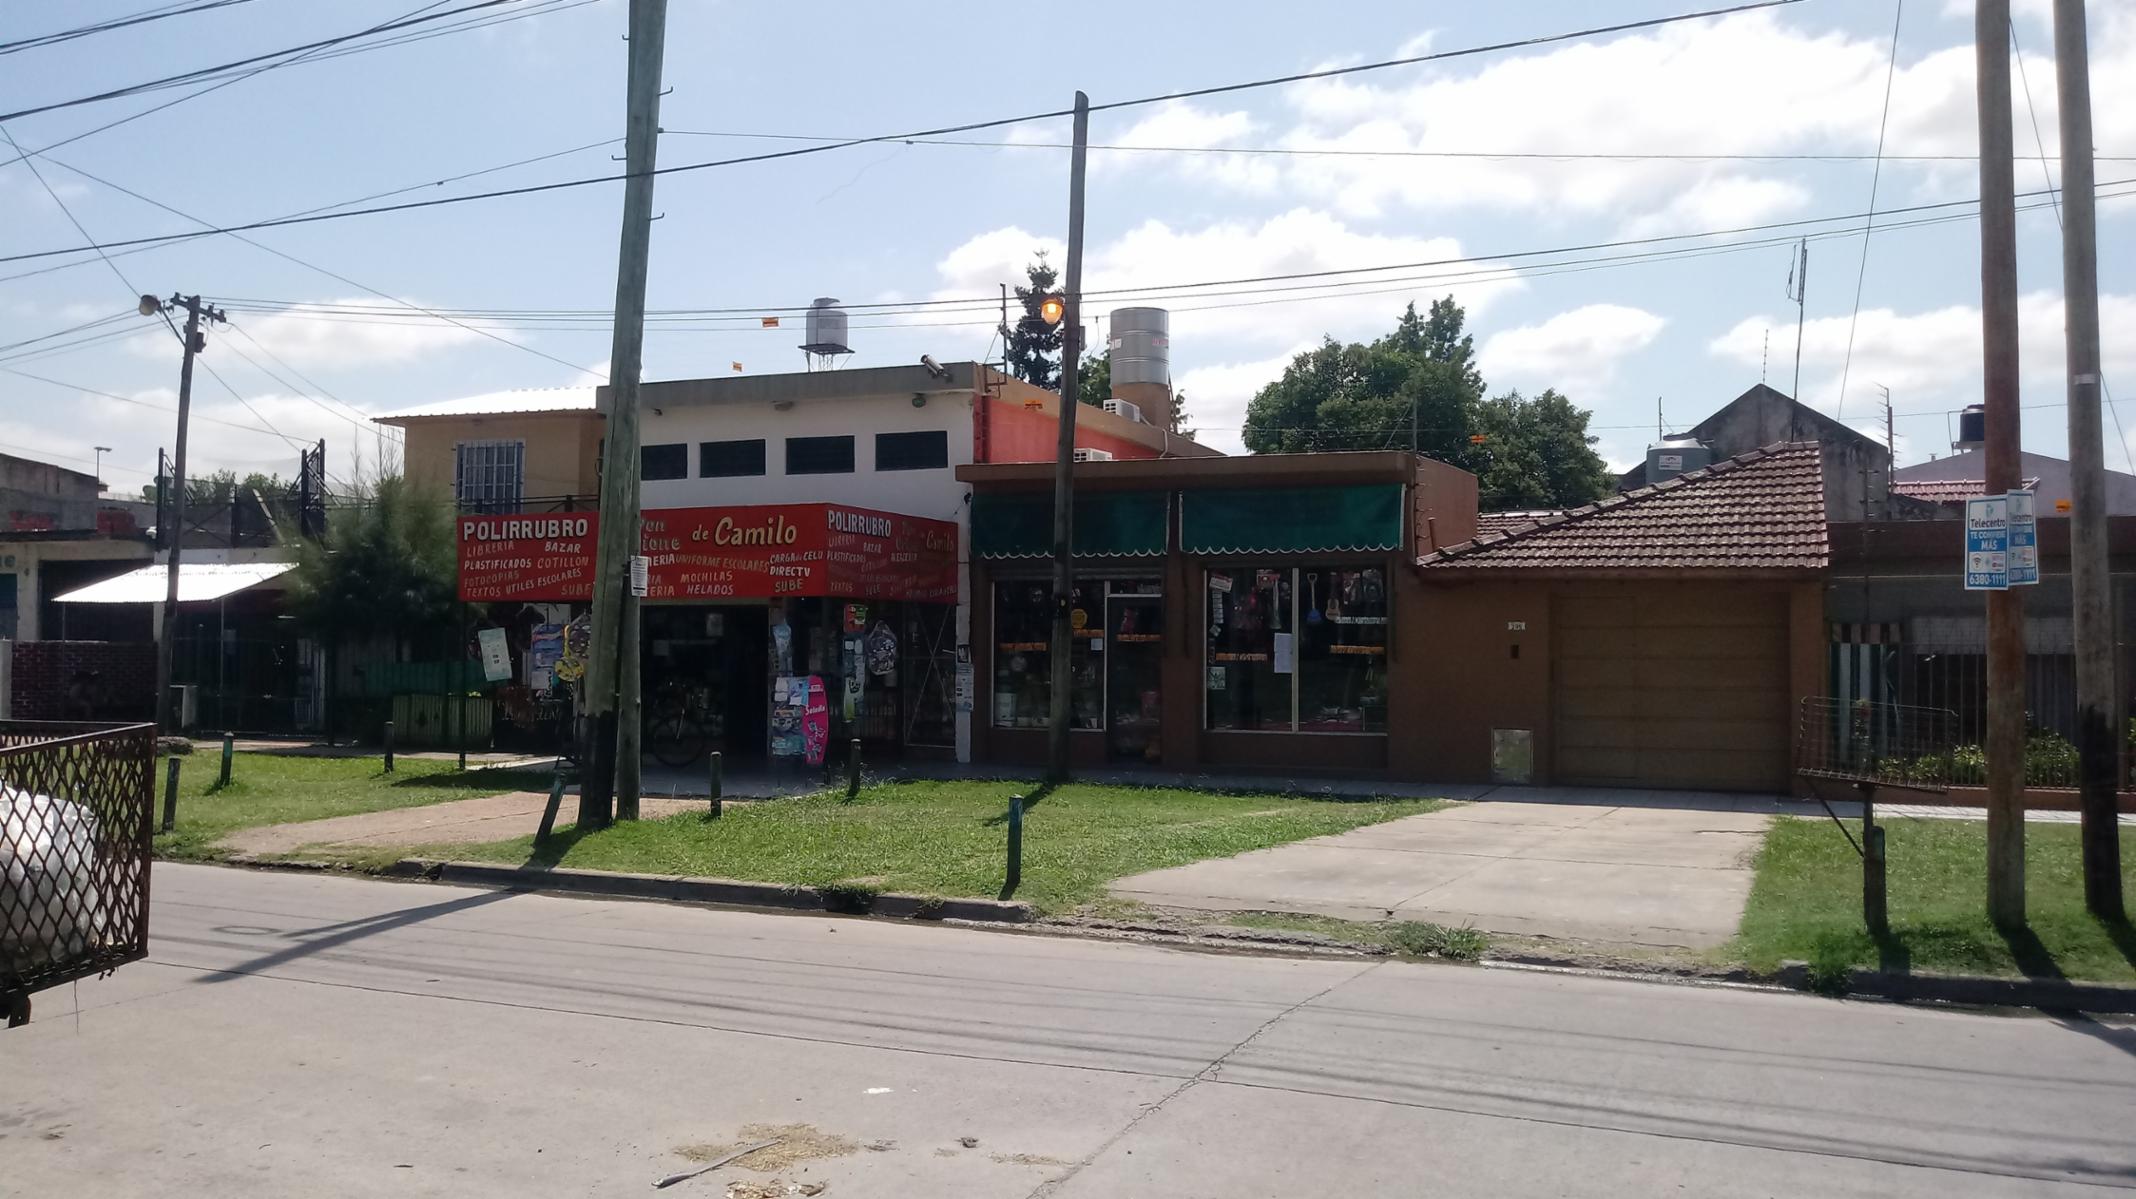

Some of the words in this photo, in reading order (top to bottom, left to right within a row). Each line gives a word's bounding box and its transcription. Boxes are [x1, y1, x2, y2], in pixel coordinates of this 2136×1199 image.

[463, 518, 589, 541] POLIRRUBRO
[692, 524, 709, 541] de
[715, 515, 797, 545] Camilo
[828, 509, 892, 537] POLIRRUBRO
[1970, 518, 2006, 528] Telecentro
[466, 540, 515, 558] LIBRERIA
[544, 541, 582, 554] BAZAR
[464, 558, 532, 571] PLASTIFICADOS
[537, 556, 590, 569] COTILLON
[769, 552, 796, 565] CARGA
[464, 569, 520, 588] FOTOCOPIAS
[681, 570, 733, 584] MOCHILAS
[769, 566, 811, 577] DIRECTV
[506, 580, 534, 595] UTILES
[537, 567, 583, 587] ESCOLARES
[774, 578, 804, 593] SUBE
[1969, 573, 2006, 585] 6380-1111
[465, 587, 501, 598] TEXTOS
[561, 583, 591, 596] SUBE
[686, 584, 734, 596] HELADOS
